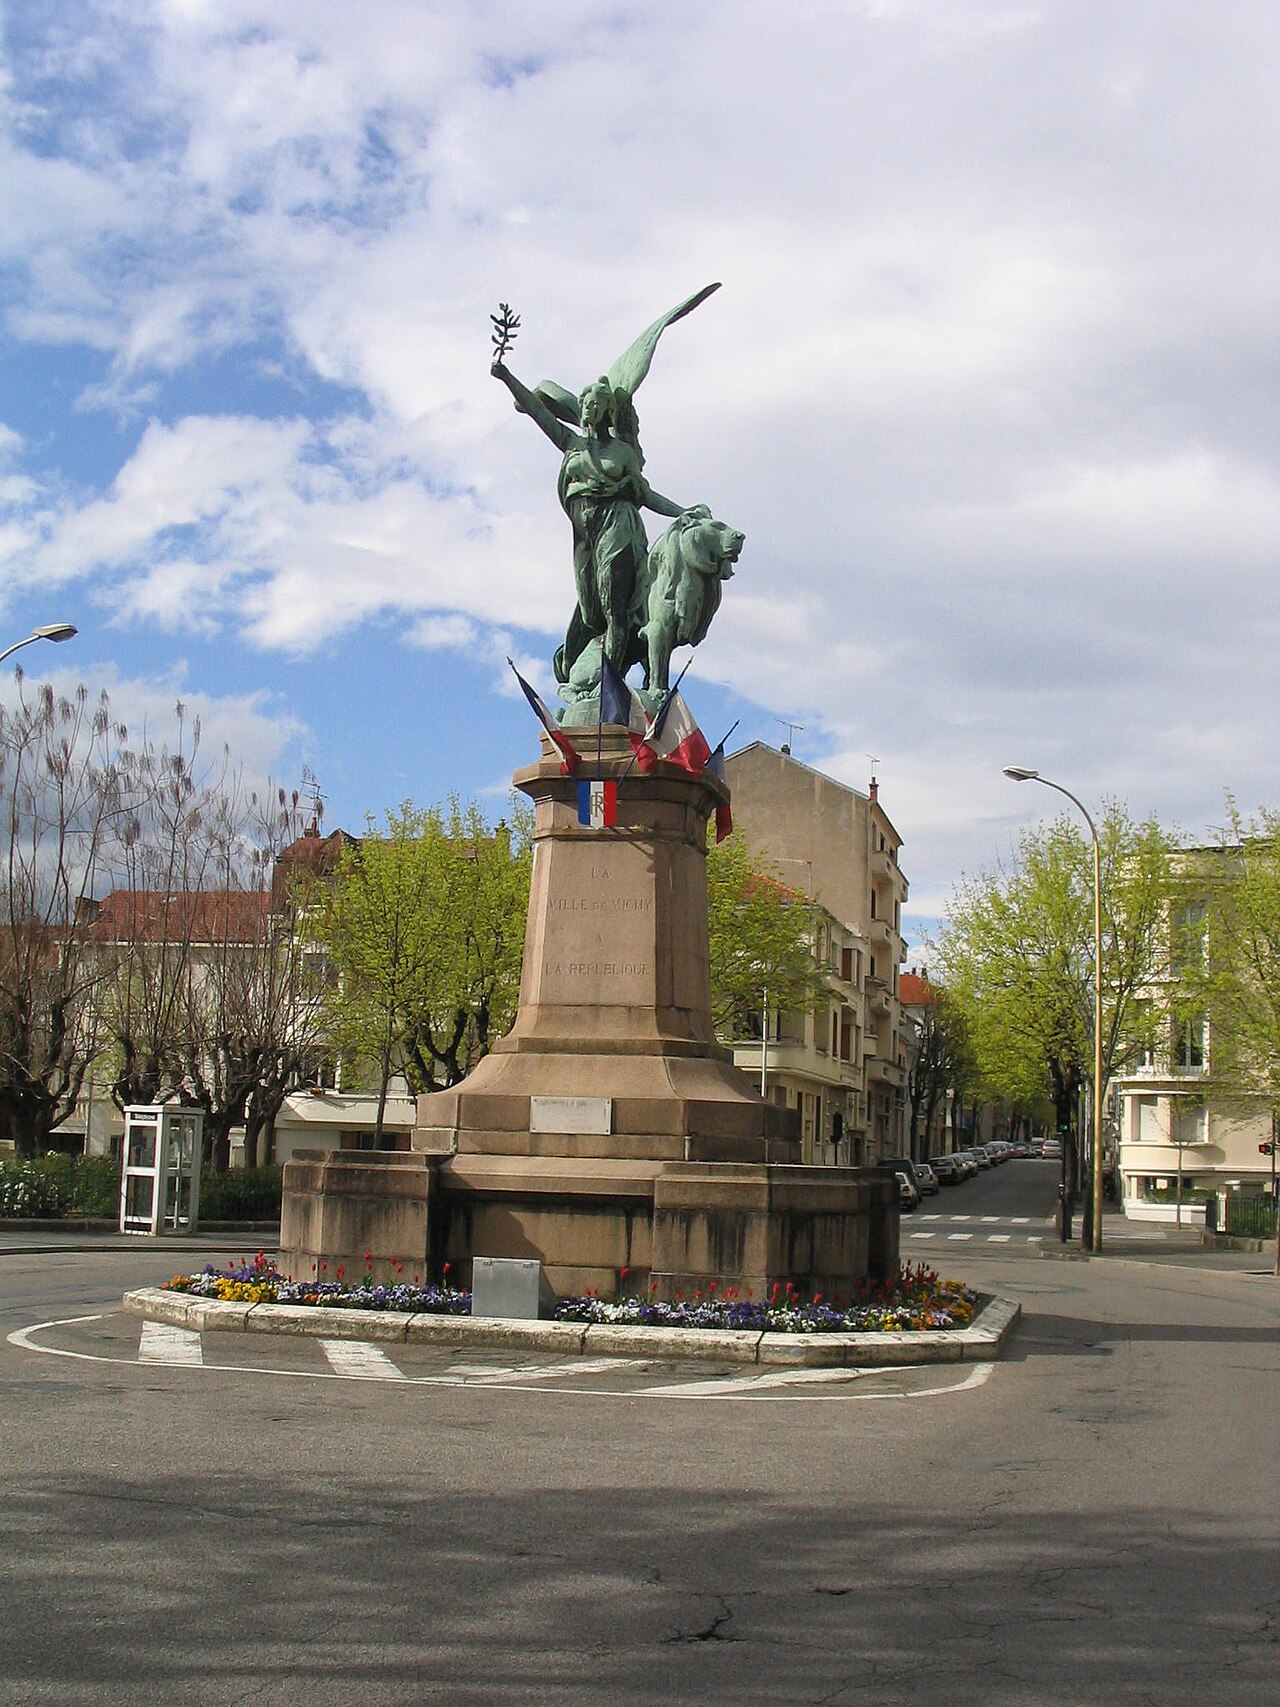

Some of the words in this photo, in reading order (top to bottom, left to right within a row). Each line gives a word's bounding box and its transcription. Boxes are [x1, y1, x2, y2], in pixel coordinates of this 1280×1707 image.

[591, 867, 611, 879] LA
[549, 899, 587, 911] VILLE
[613, 899, 653, 911] VICHY
[545, 963, 561, 975] LA
